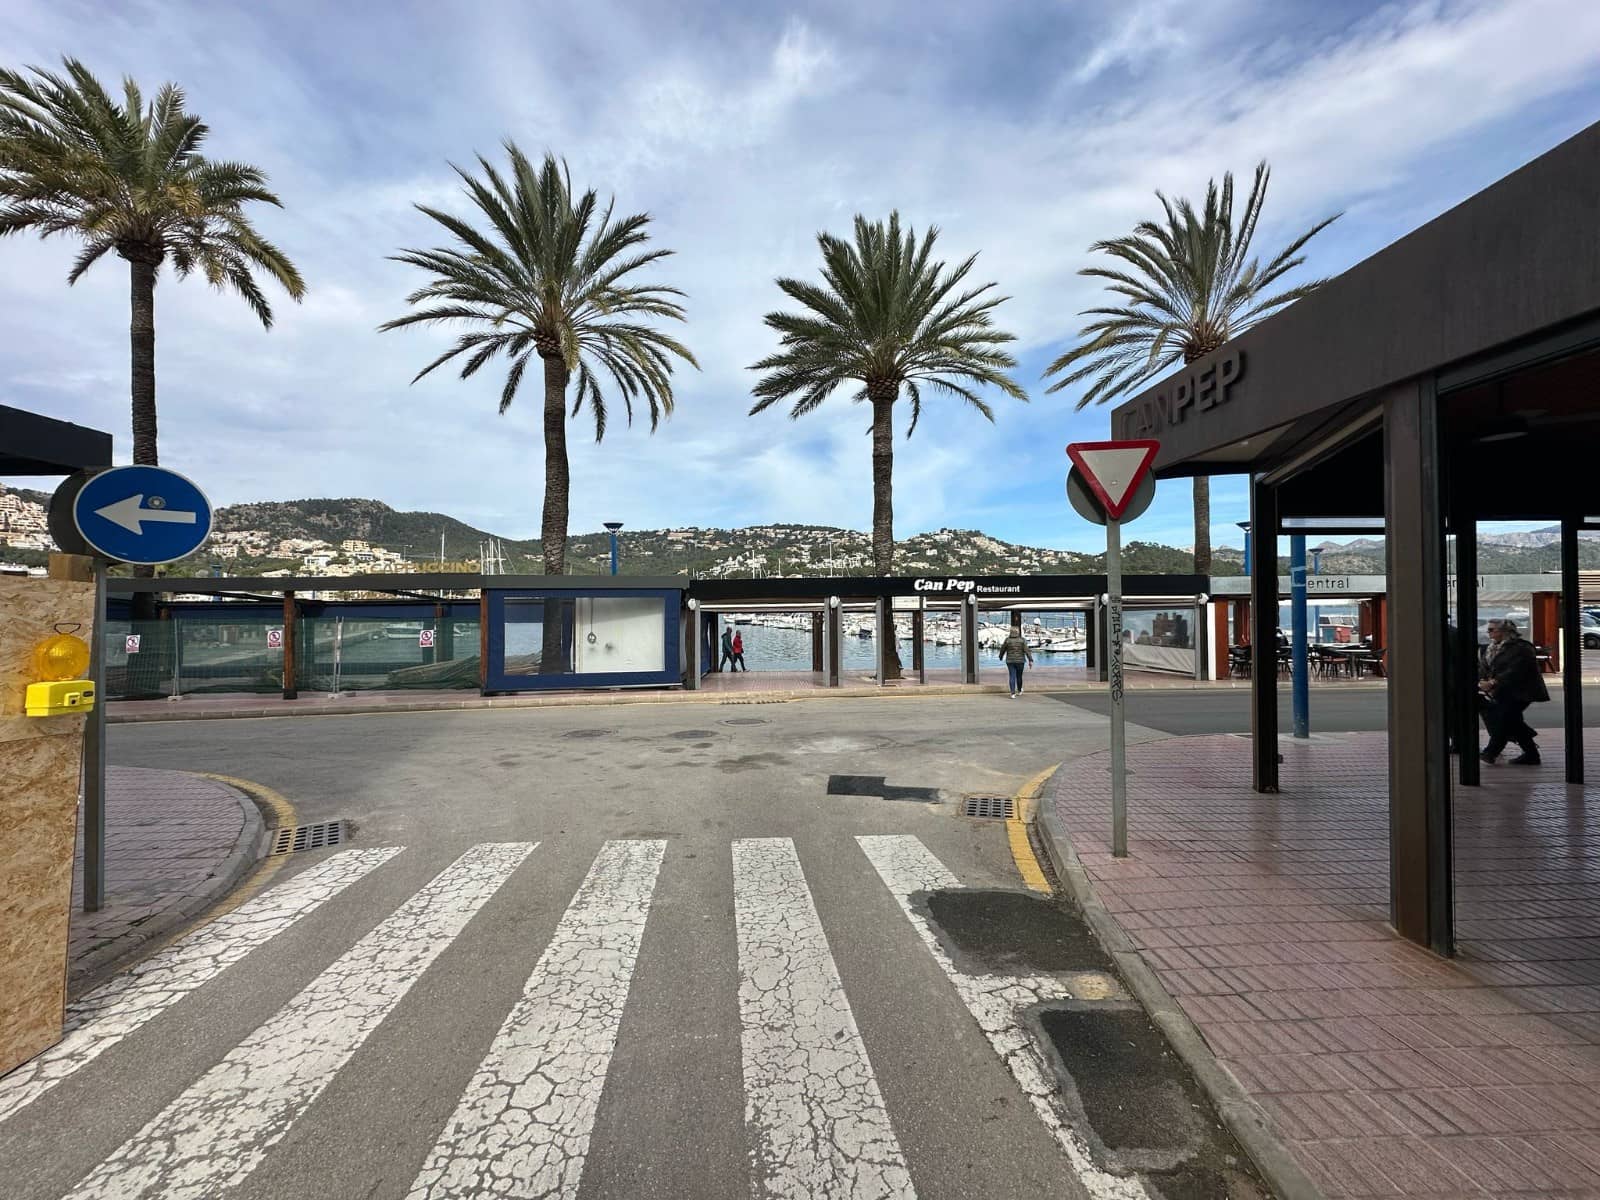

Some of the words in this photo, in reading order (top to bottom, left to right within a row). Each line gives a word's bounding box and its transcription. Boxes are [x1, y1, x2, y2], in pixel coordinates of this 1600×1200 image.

[914, 578, 943, 591] Can
[946, 578, 975, 593] Pep
[976, 585, 1020, 593] Restaurant
[1307, 577, 1350, 589] entral
